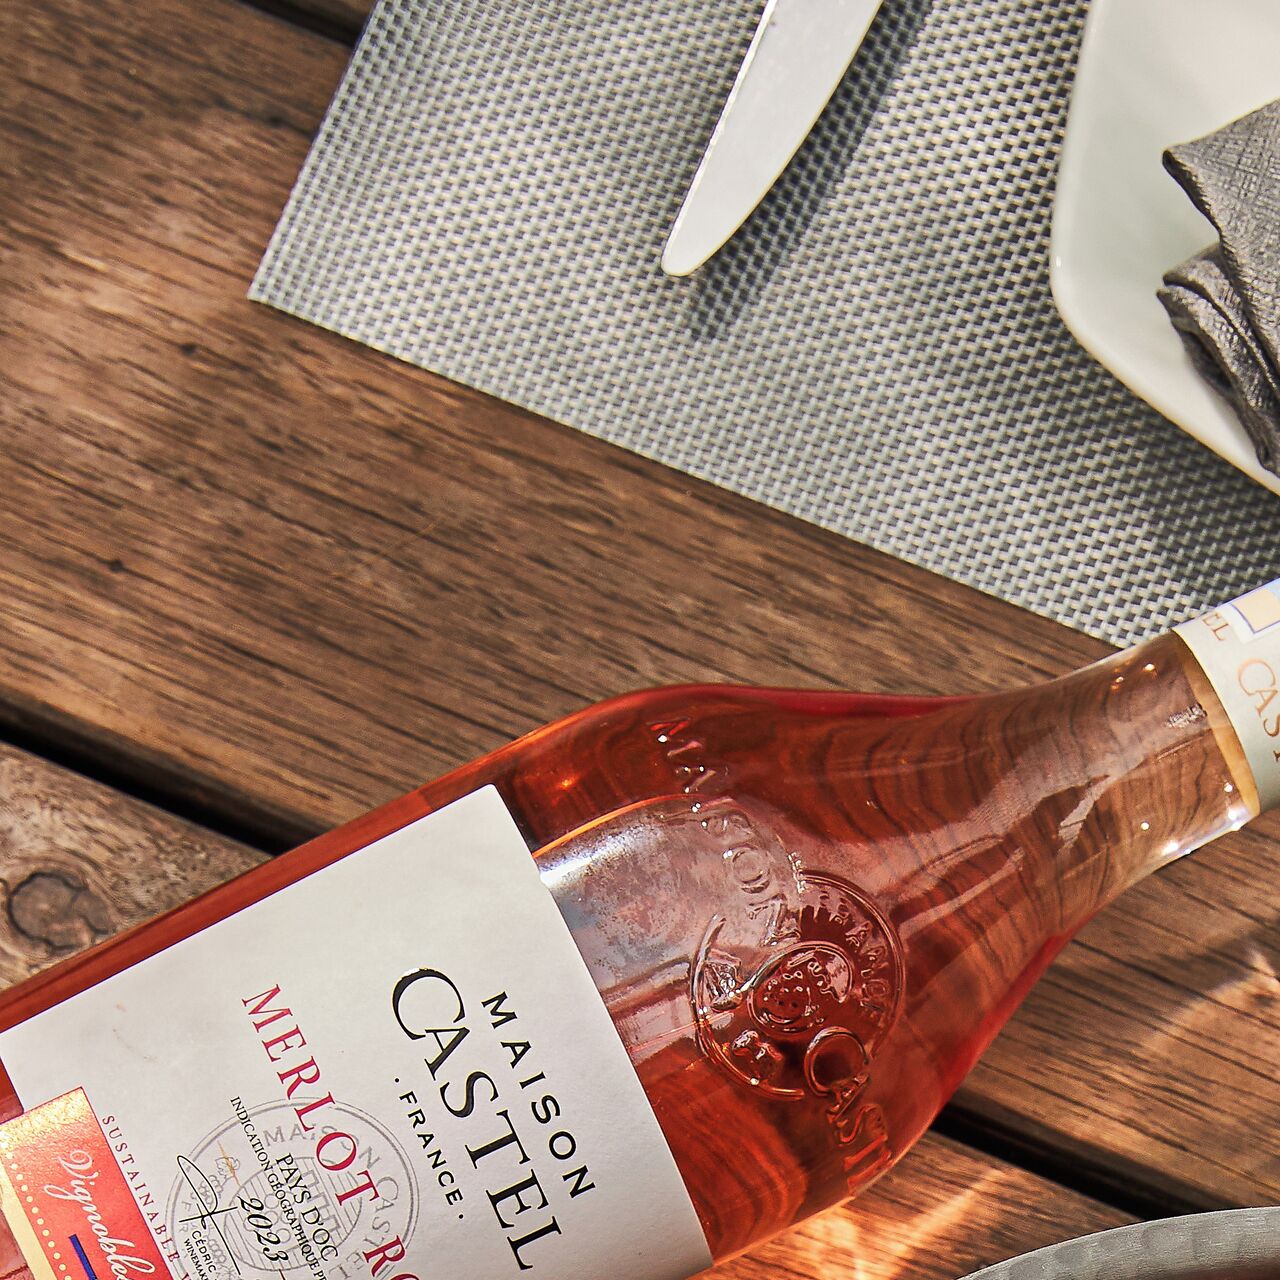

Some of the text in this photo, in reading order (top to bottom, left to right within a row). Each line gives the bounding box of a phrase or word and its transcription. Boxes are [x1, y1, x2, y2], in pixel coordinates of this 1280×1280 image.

[241, 983, 380, 1206] MERLOT
[392, 967, 562, 1271] CASTEL
[399, 1090, 464, 1206] FRANCE
[481, 991, 596, 1199] MAISON
[102, 1115, 180, 1263] SUSTAINABLE
[192, 1230, 217, 1273] CÉDRIC
[230, 1096, 272, 1172] INDICATION
[267, 1171, 320, 1270] GÉOGRAPHIQUE
[237, 1195, 289, 1262] 2023
[276, 1152, 339, 1262] PAYS D'OC
